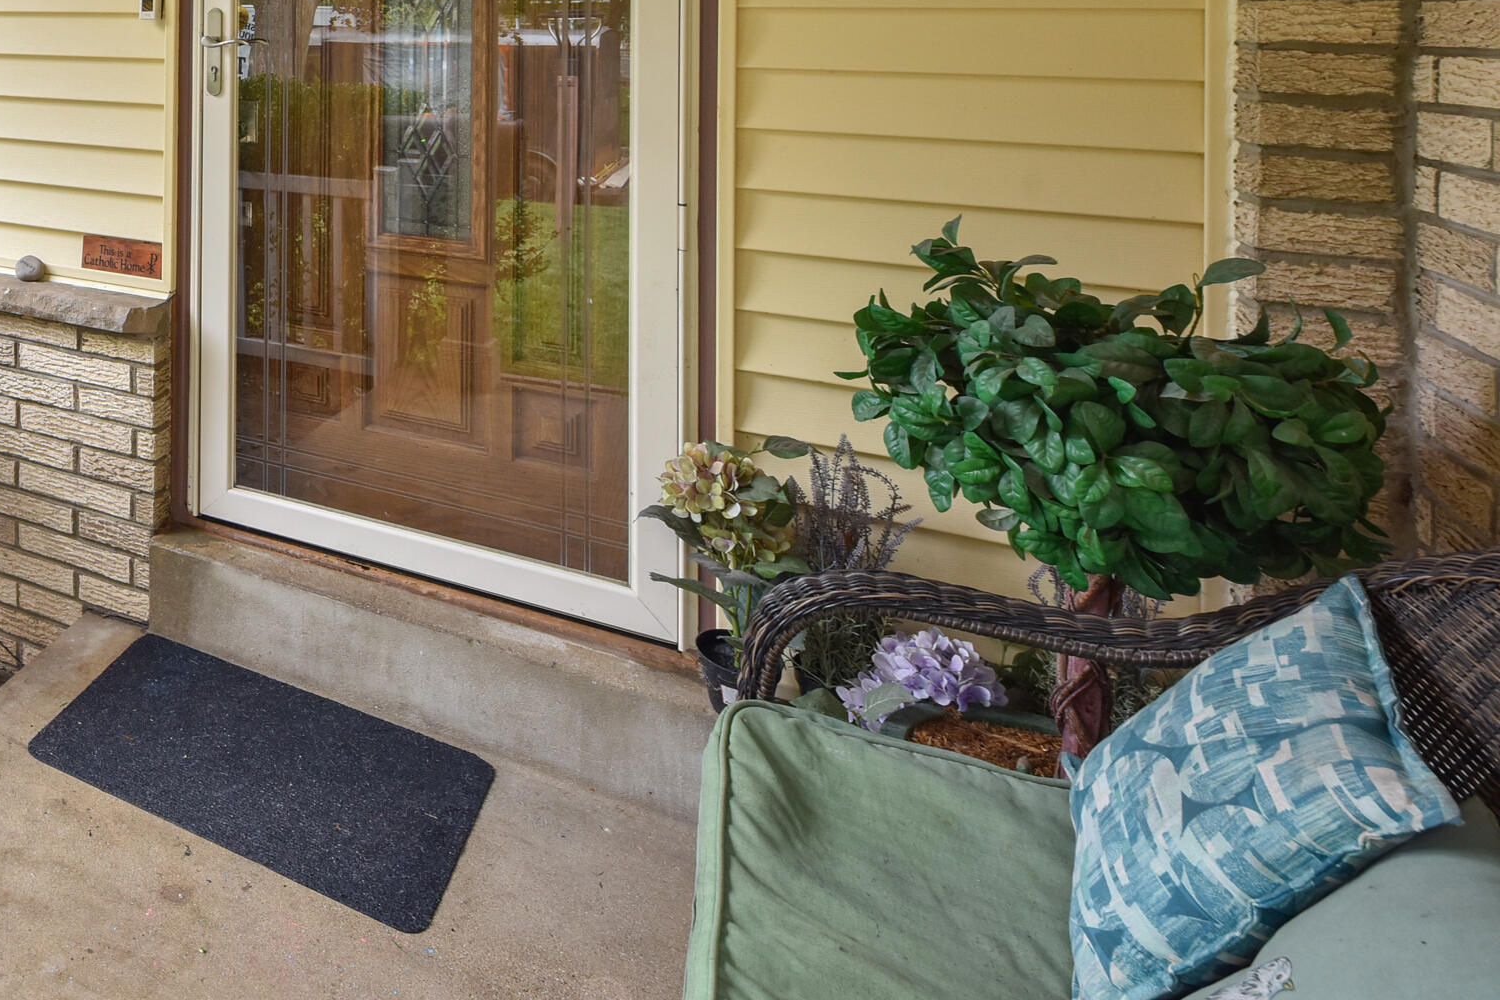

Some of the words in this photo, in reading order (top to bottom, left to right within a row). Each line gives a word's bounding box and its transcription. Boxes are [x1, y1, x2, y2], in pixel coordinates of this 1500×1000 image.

[100, 244, 116, 256] This
[117, 247, 124, 257] is
[126, 250, 132, 259] a
[84, 253, 118, 270] Catholic
[120, 258, 146, 273] Home
